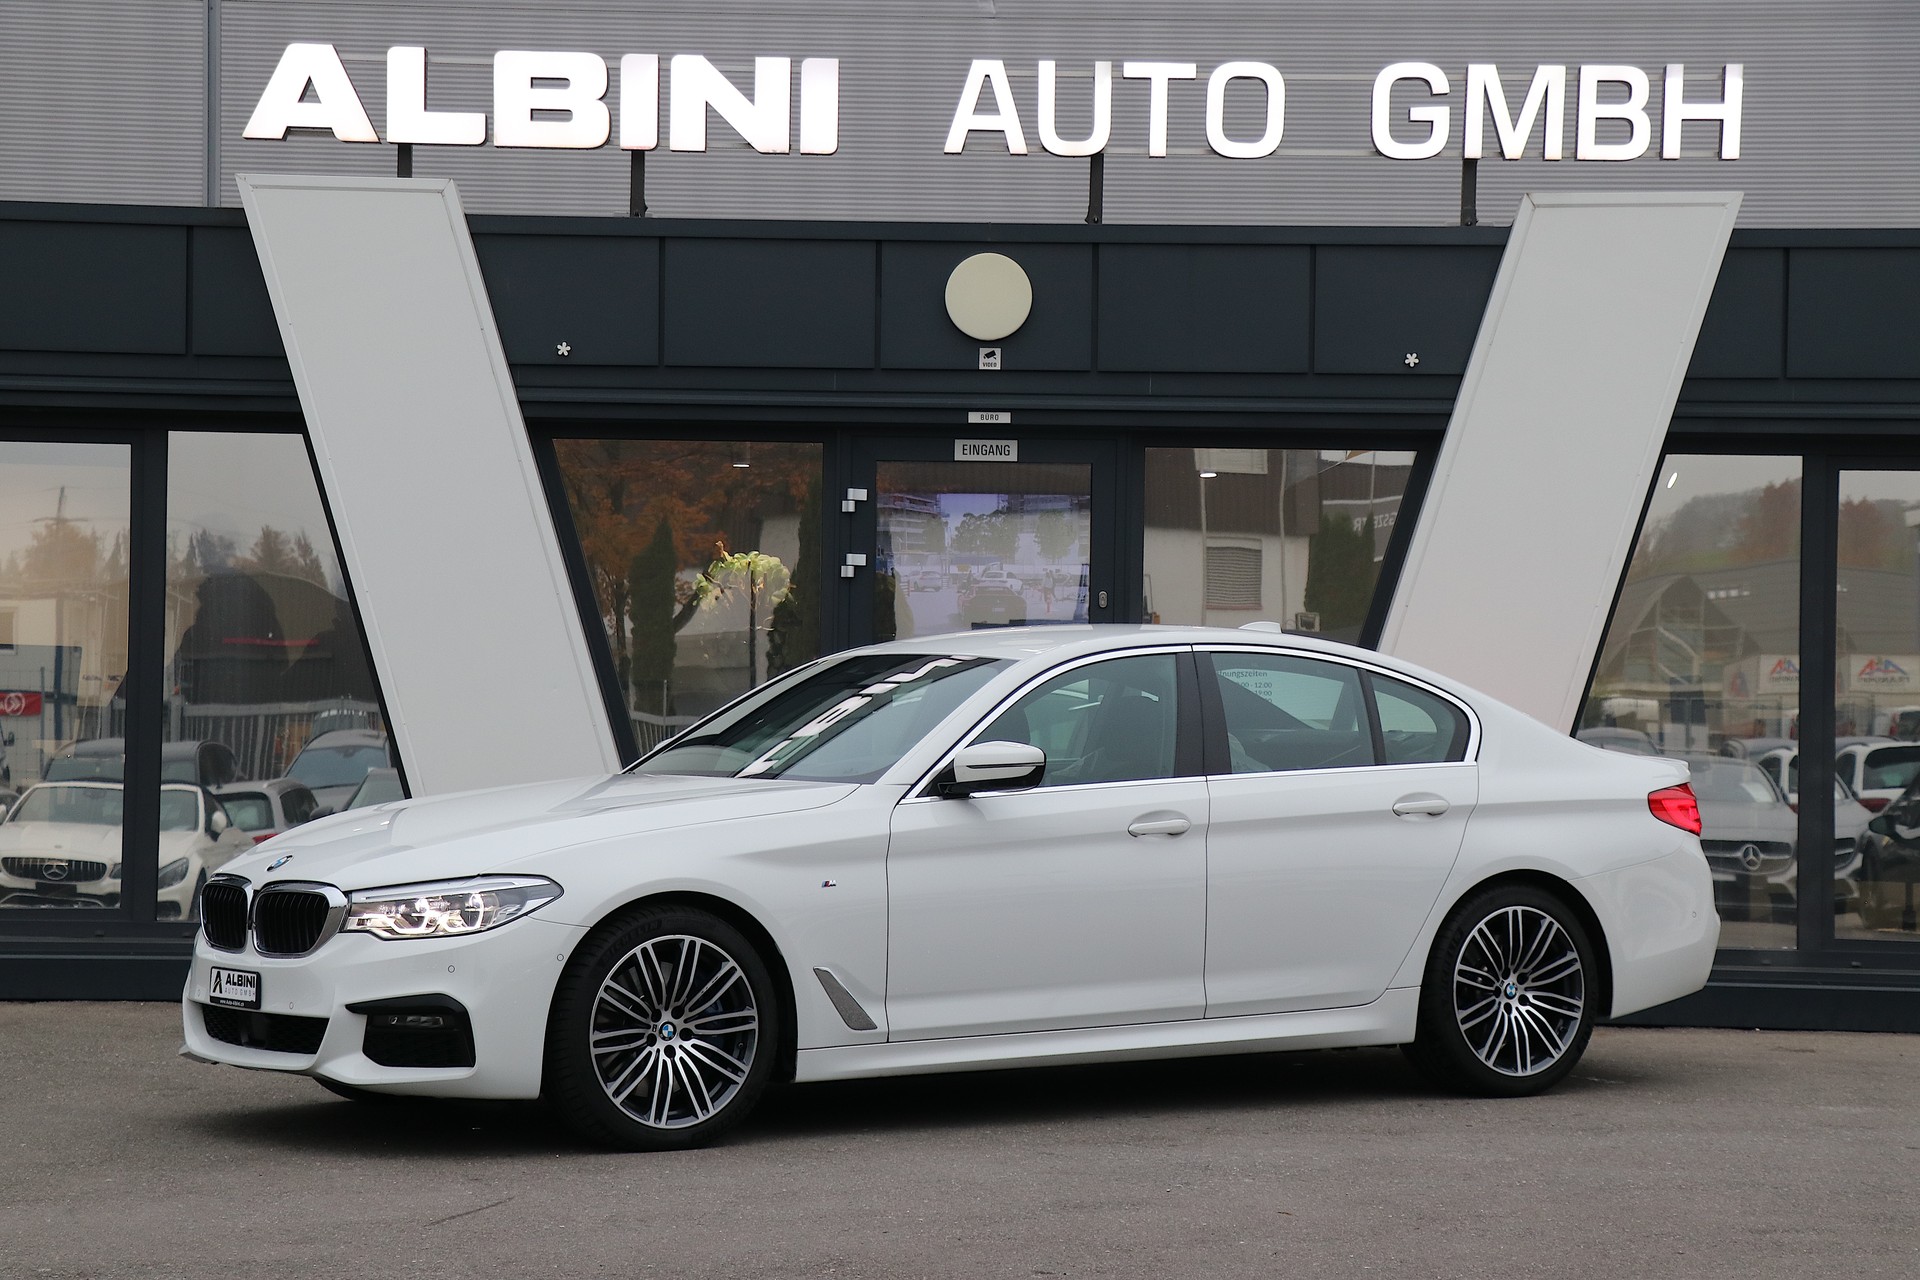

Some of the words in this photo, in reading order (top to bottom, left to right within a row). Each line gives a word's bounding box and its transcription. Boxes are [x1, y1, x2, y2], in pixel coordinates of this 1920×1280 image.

[242, 42, 840, 155] ALBINI
[943, 58, 1287, 160] AUTO
[1371, 62, 1744, 163] GMBH
[980, 413, 999, 421] BÜRO
[962, 444, 1011, 456] EINGANG
[225, 973, 256, 988] ALBINI
